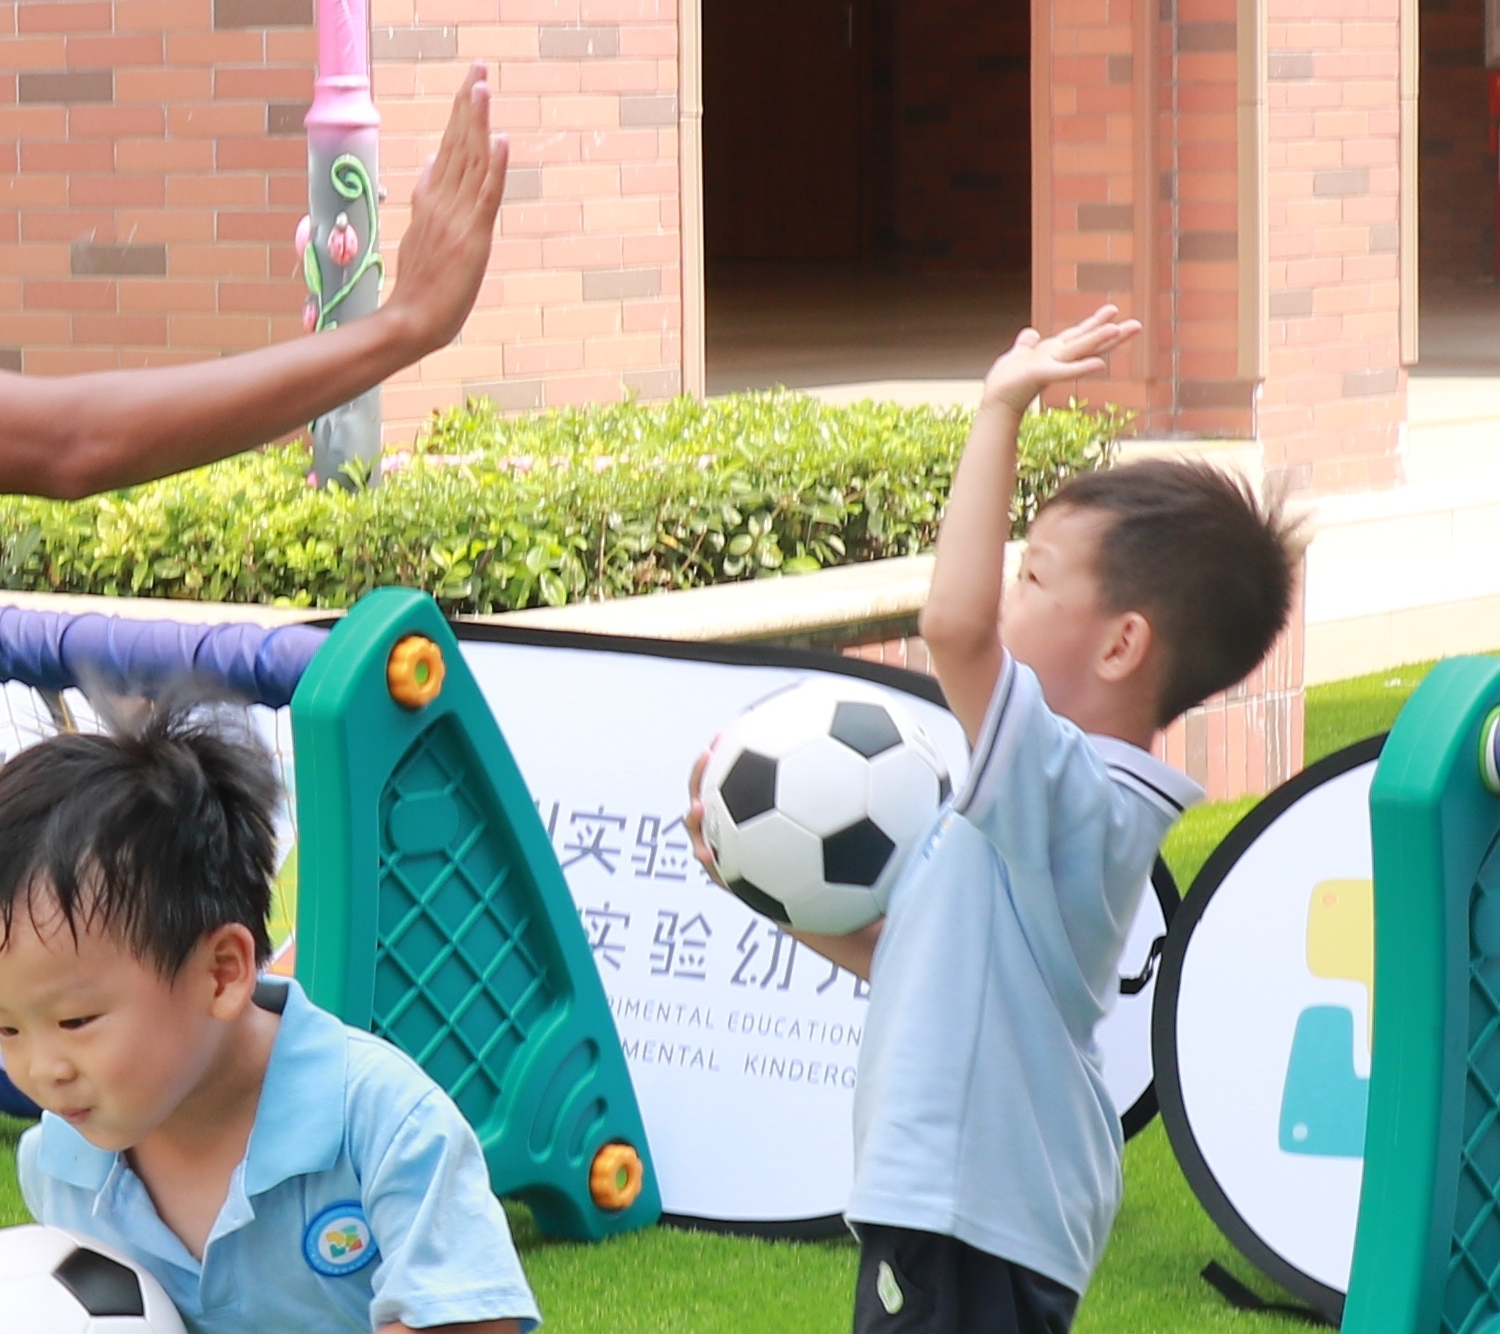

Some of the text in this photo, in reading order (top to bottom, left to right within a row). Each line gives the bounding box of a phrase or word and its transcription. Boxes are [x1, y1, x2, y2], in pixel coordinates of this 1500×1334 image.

[540, 800, 716, 886] 实验
[727, 1011, 862, 1047] EDUCATION
[621, 1039, 858, 1088] MENTAL KINDERG
